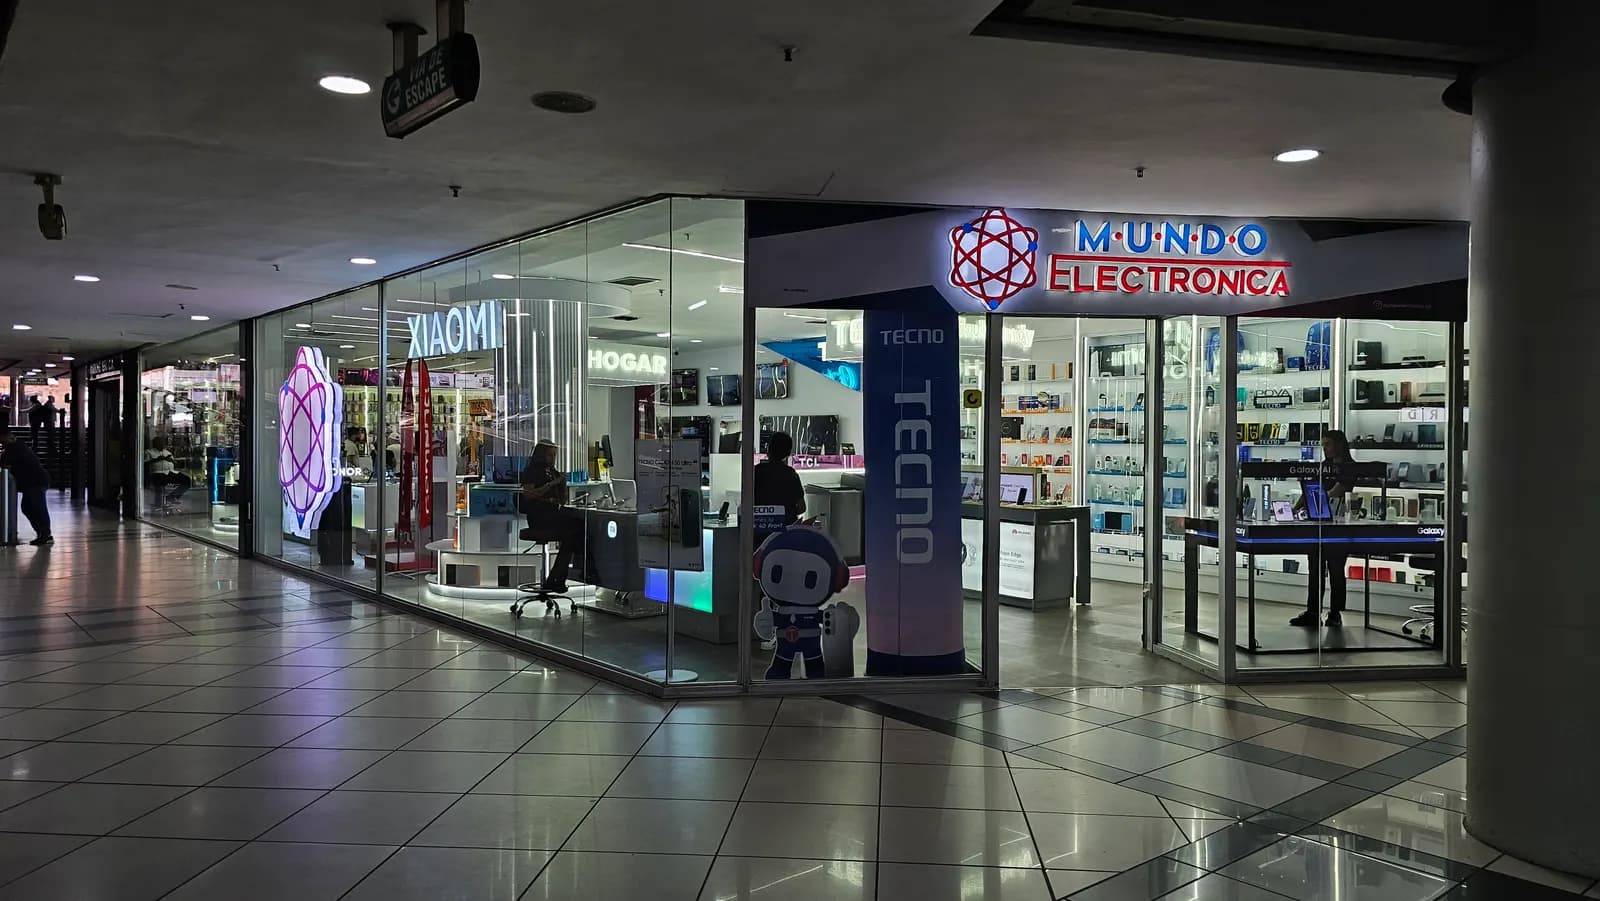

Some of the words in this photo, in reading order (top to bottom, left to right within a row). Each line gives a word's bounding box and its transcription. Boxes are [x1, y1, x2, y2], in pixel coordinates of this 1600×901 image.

[405, 67, 447, 109] ESCAPE
[1045, 254, 1291, 297] ELECTRONICA
[407, 300, 503, 359] XIAOMI
[879, 328, 945, 346] TECNO
[588, 349, 668, 374] HOGAR
[799, 457, 821, 468] TCL
[1289, 465, 1321, 477] Galaxy
[332, 467, 363, 477] ONOR
[894, 379, 934, 565] TECNO
[753, 506, 775, 514] ECNO
[1417, 527, 1446, 537] Galaxy
